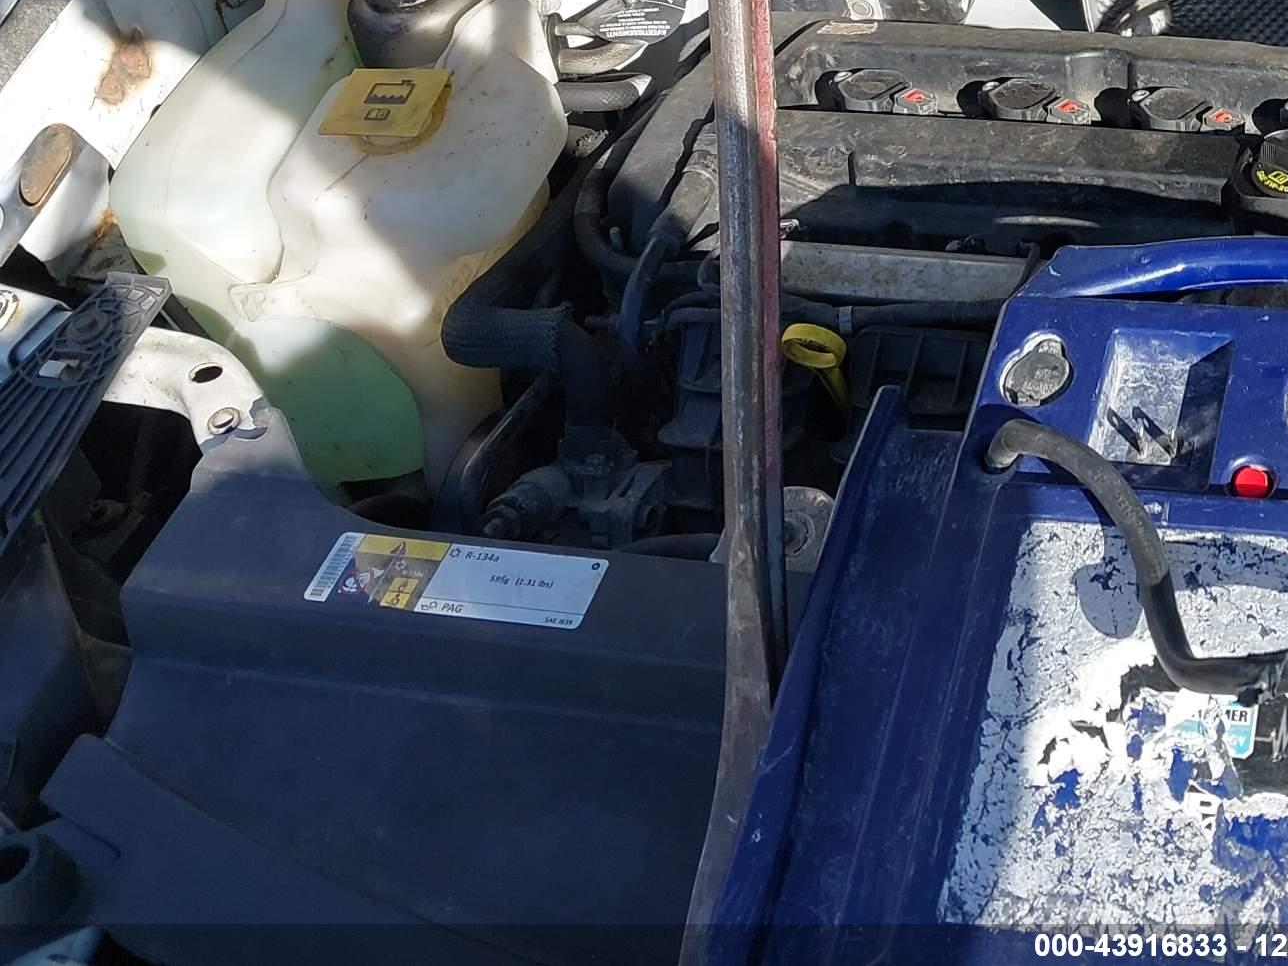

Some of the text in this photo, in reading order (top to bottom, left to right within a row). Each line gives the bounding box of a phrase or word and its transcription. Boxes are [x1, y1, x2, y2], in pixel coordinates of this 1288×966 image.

[464, 551, 501, 564] R-134a
[537, 580, 554, 589] lbs)
[440, 602, 463, 614] PAG
